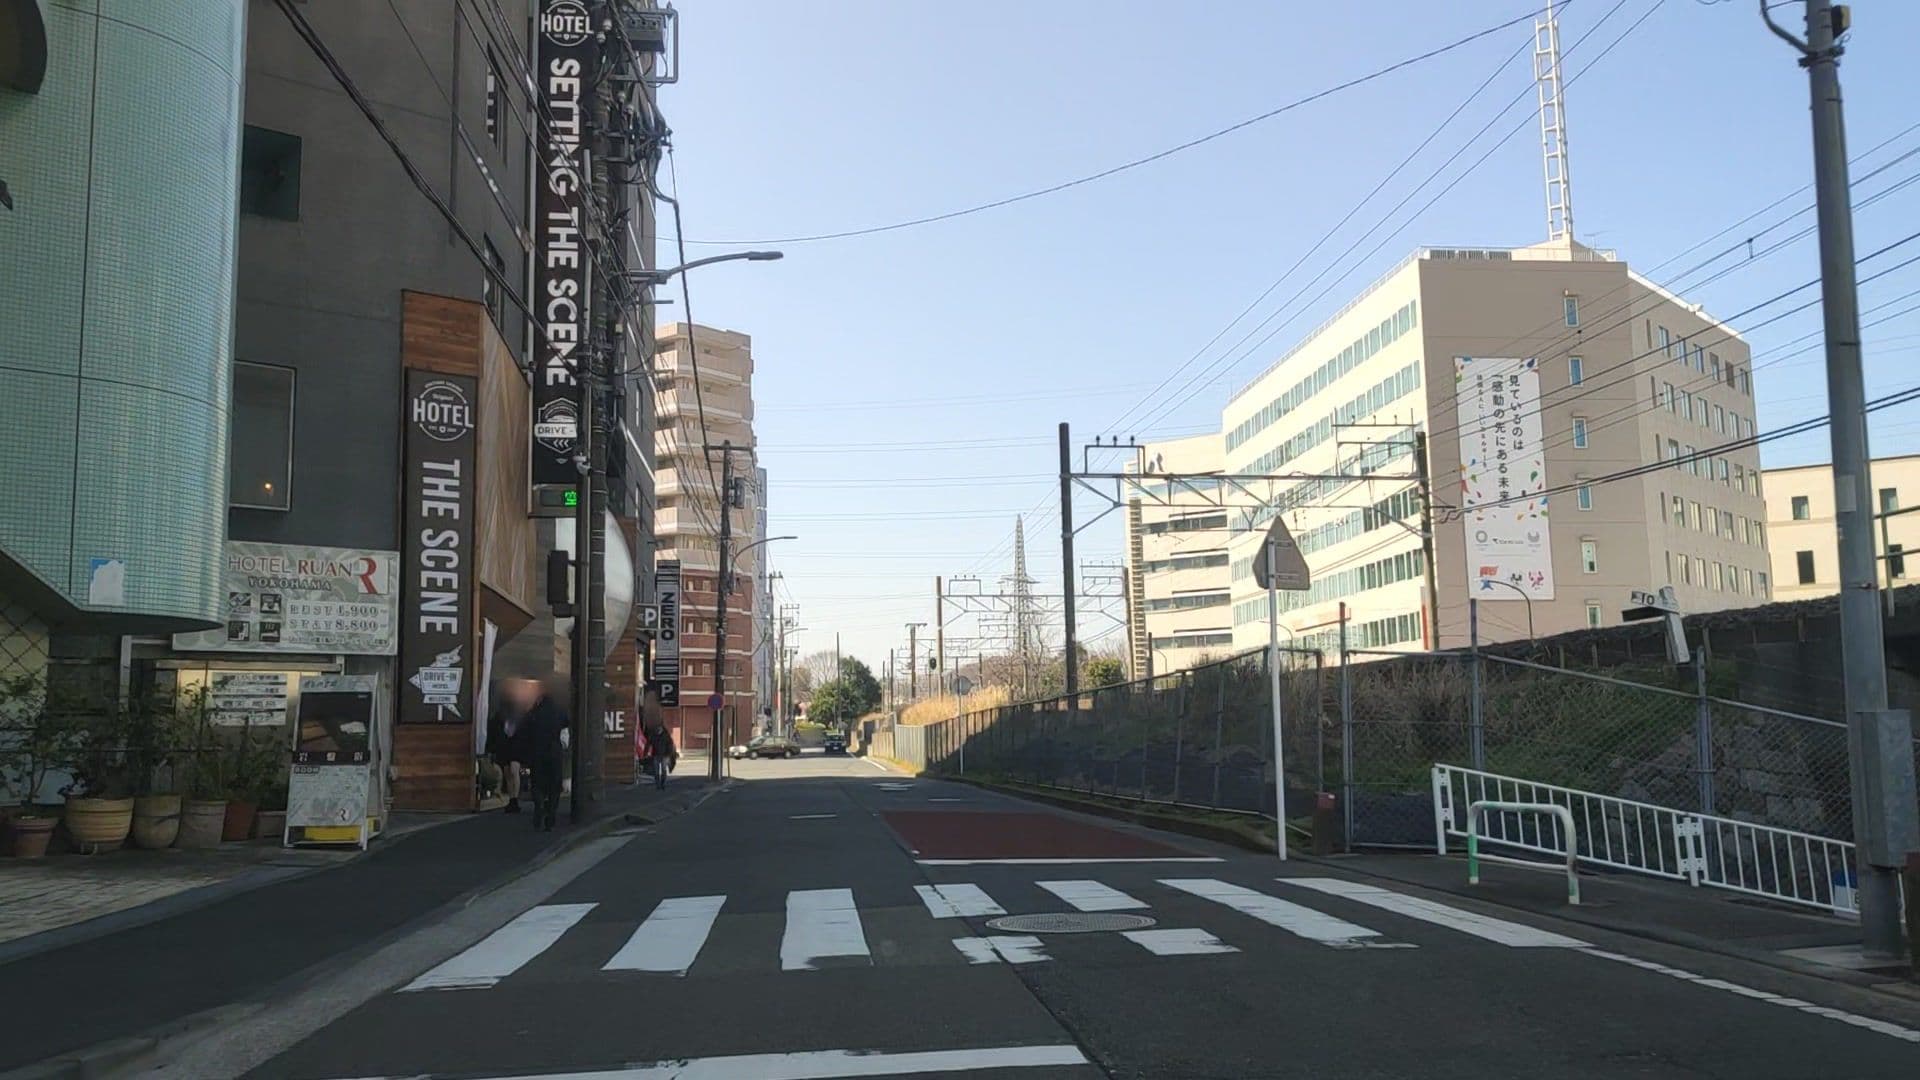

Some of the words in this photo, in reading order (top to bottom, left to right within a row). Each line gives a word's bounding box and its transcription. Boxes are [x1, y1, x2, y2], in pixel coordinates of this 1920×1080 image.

[541, 13, 594, 34] HOTEL
[549, 58, 580, 196] SETTING
[548, 207, 578, 268] THE
[546, 279, 578, 386] SCENE
[413, 398, 474, 428] HOTEL
[1509, 375, 1524, 450] 見ているのは
[422, 459, 460, 519] THE
[228, 557, 291, 573] HOTEL
[298, 560, 352, 577] RUAN
[248, 576, 332, 591] YOKOHAMA
[420, 528, 460, 634] SCENE
[644, 607, 657, 627] P
[660, 592, 675, 641] ZERO
[423, 671, 457, 681] DRIVE-IN
[661, 684, 674, 698] P
